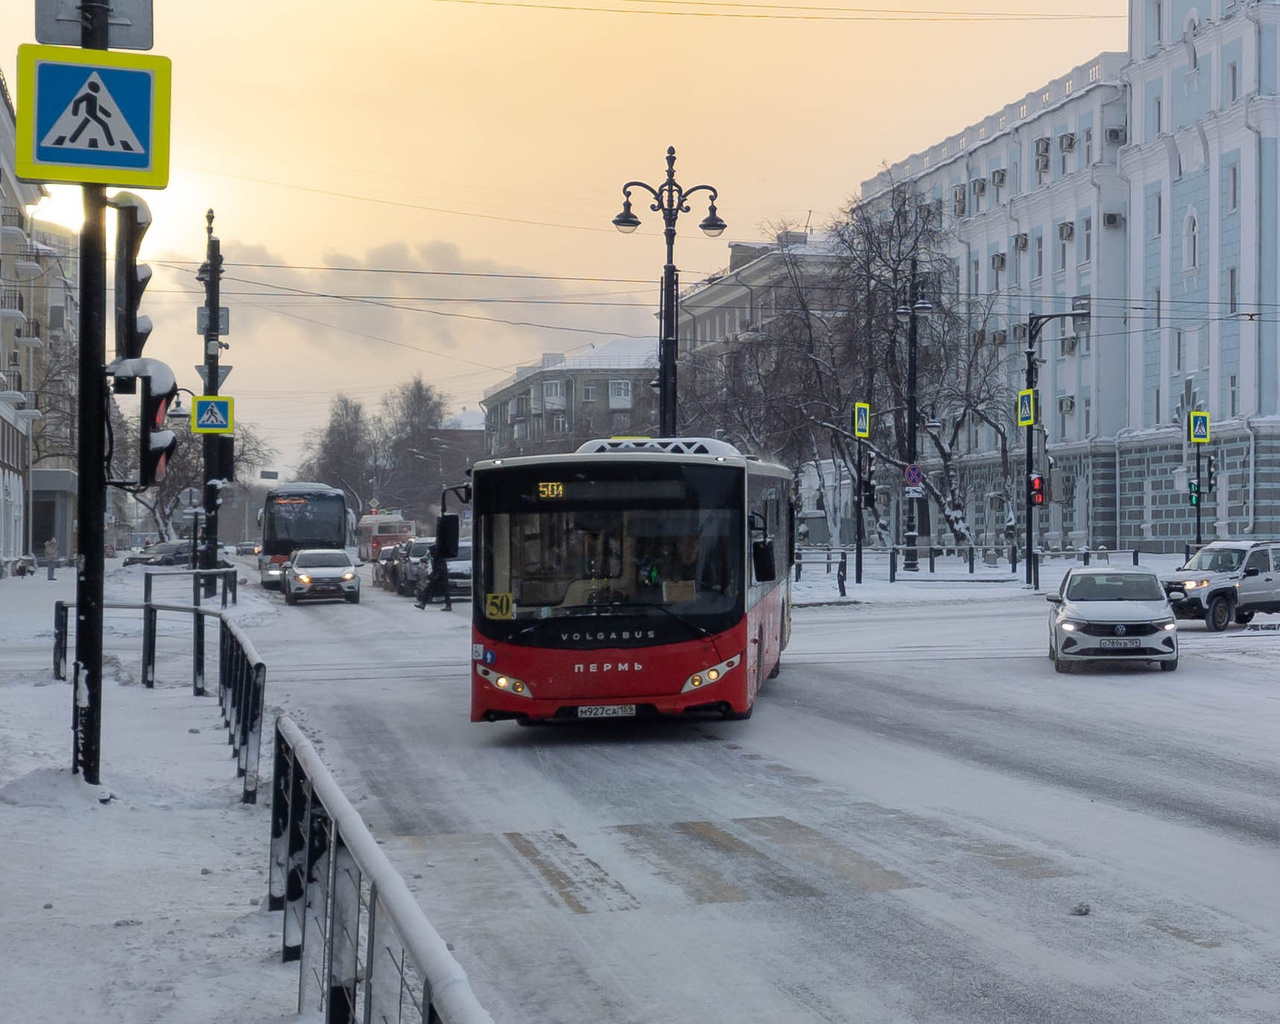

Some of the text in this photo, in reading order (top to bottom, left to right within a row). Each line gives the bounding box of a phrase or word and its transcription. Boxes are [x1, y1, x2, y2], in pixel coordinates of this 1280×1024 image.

[489, 594, 510, 616] 50
[561, 630, 655, 641] VOLGABUS
[574, 662, 643, 673] ПЕРМЬ
